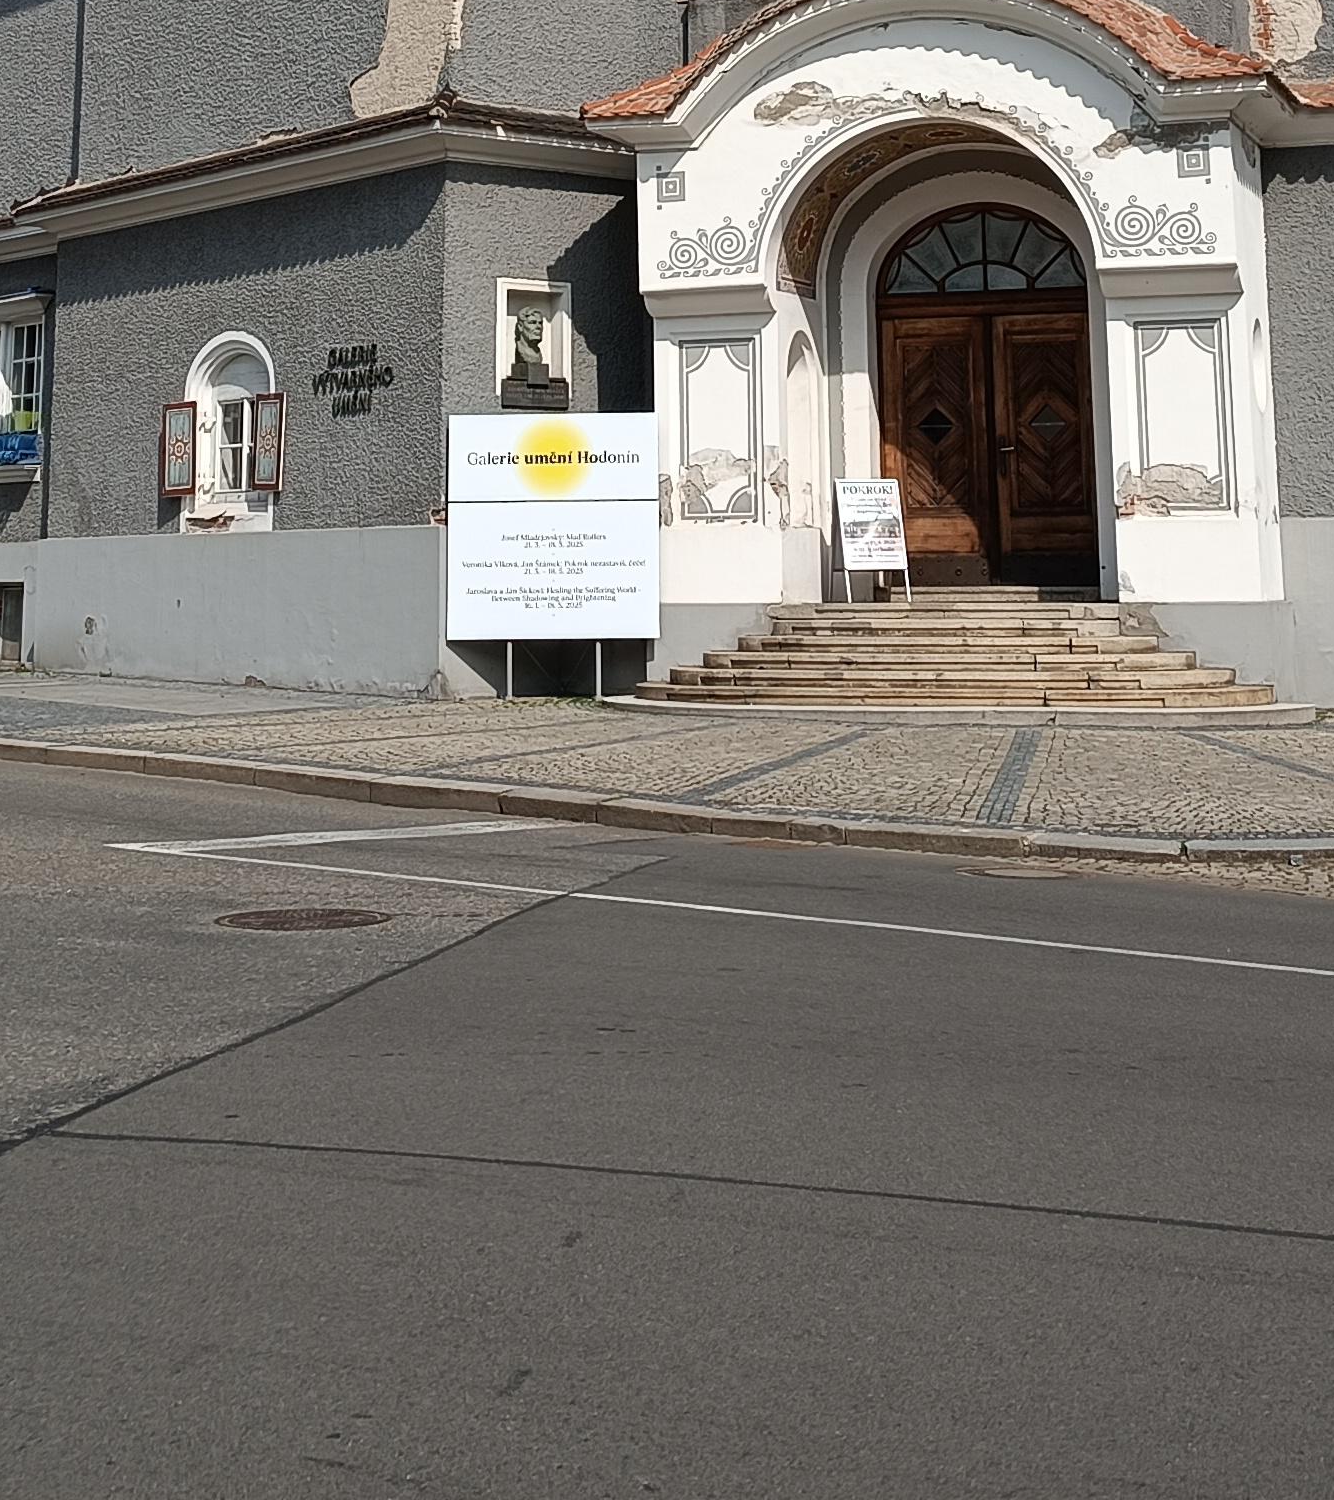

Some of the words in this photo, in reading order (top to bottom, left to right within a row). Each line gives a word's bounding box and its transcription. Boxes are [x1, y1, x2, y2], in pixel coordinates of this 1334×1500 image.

[328, 343, 378, 369] GALERIE
[467, 451, 520, 466] Galerie
[524, 450, 573, 465] umění
[577, 450, 640, 464] Hodonín
[501, 534, 520, 542] Josef
[462, 561, 493, 569] Veronika
[561, 594, 574, 602] and
